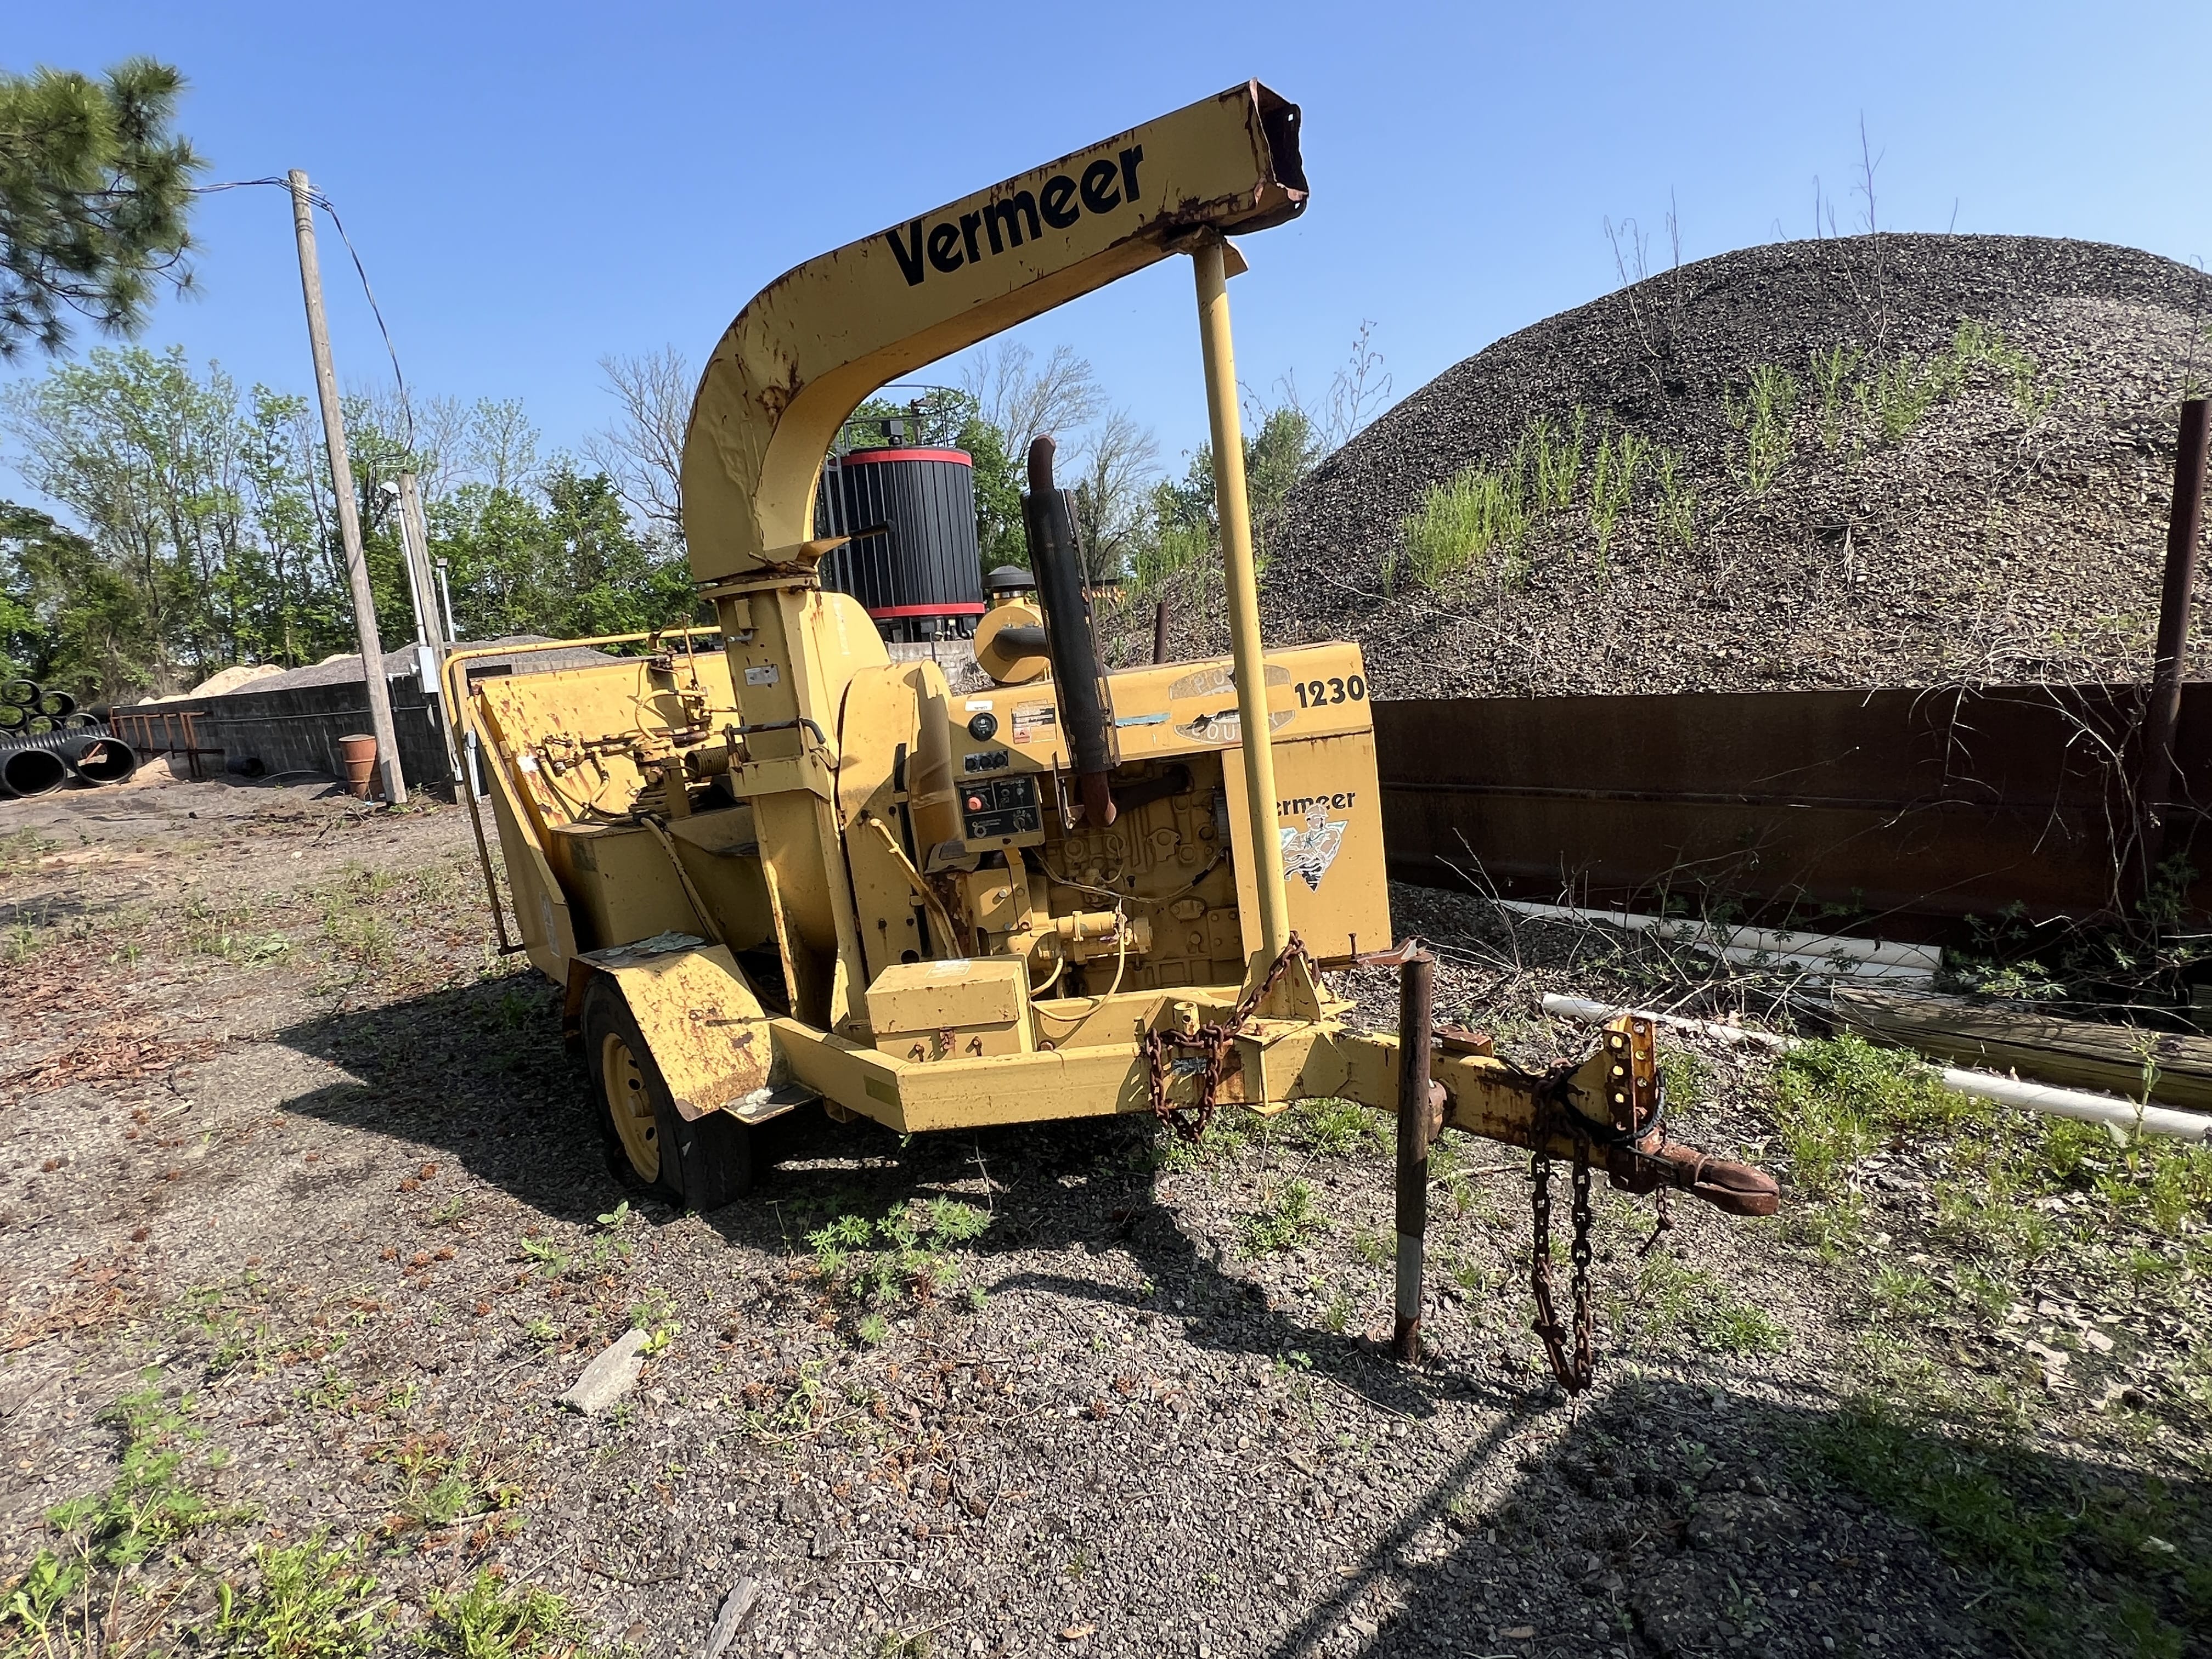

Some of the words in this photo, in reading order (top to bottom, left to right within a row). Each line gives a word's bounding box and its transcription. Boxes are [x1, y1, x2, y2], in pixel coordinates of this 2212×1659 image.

[885, 144, 1144, 287] Vermeer
[1294, 675, 1365, 709] 1230
[1192, 712, 1278, 740] COUY
[1277, 792, 1356, 816] rmeer
